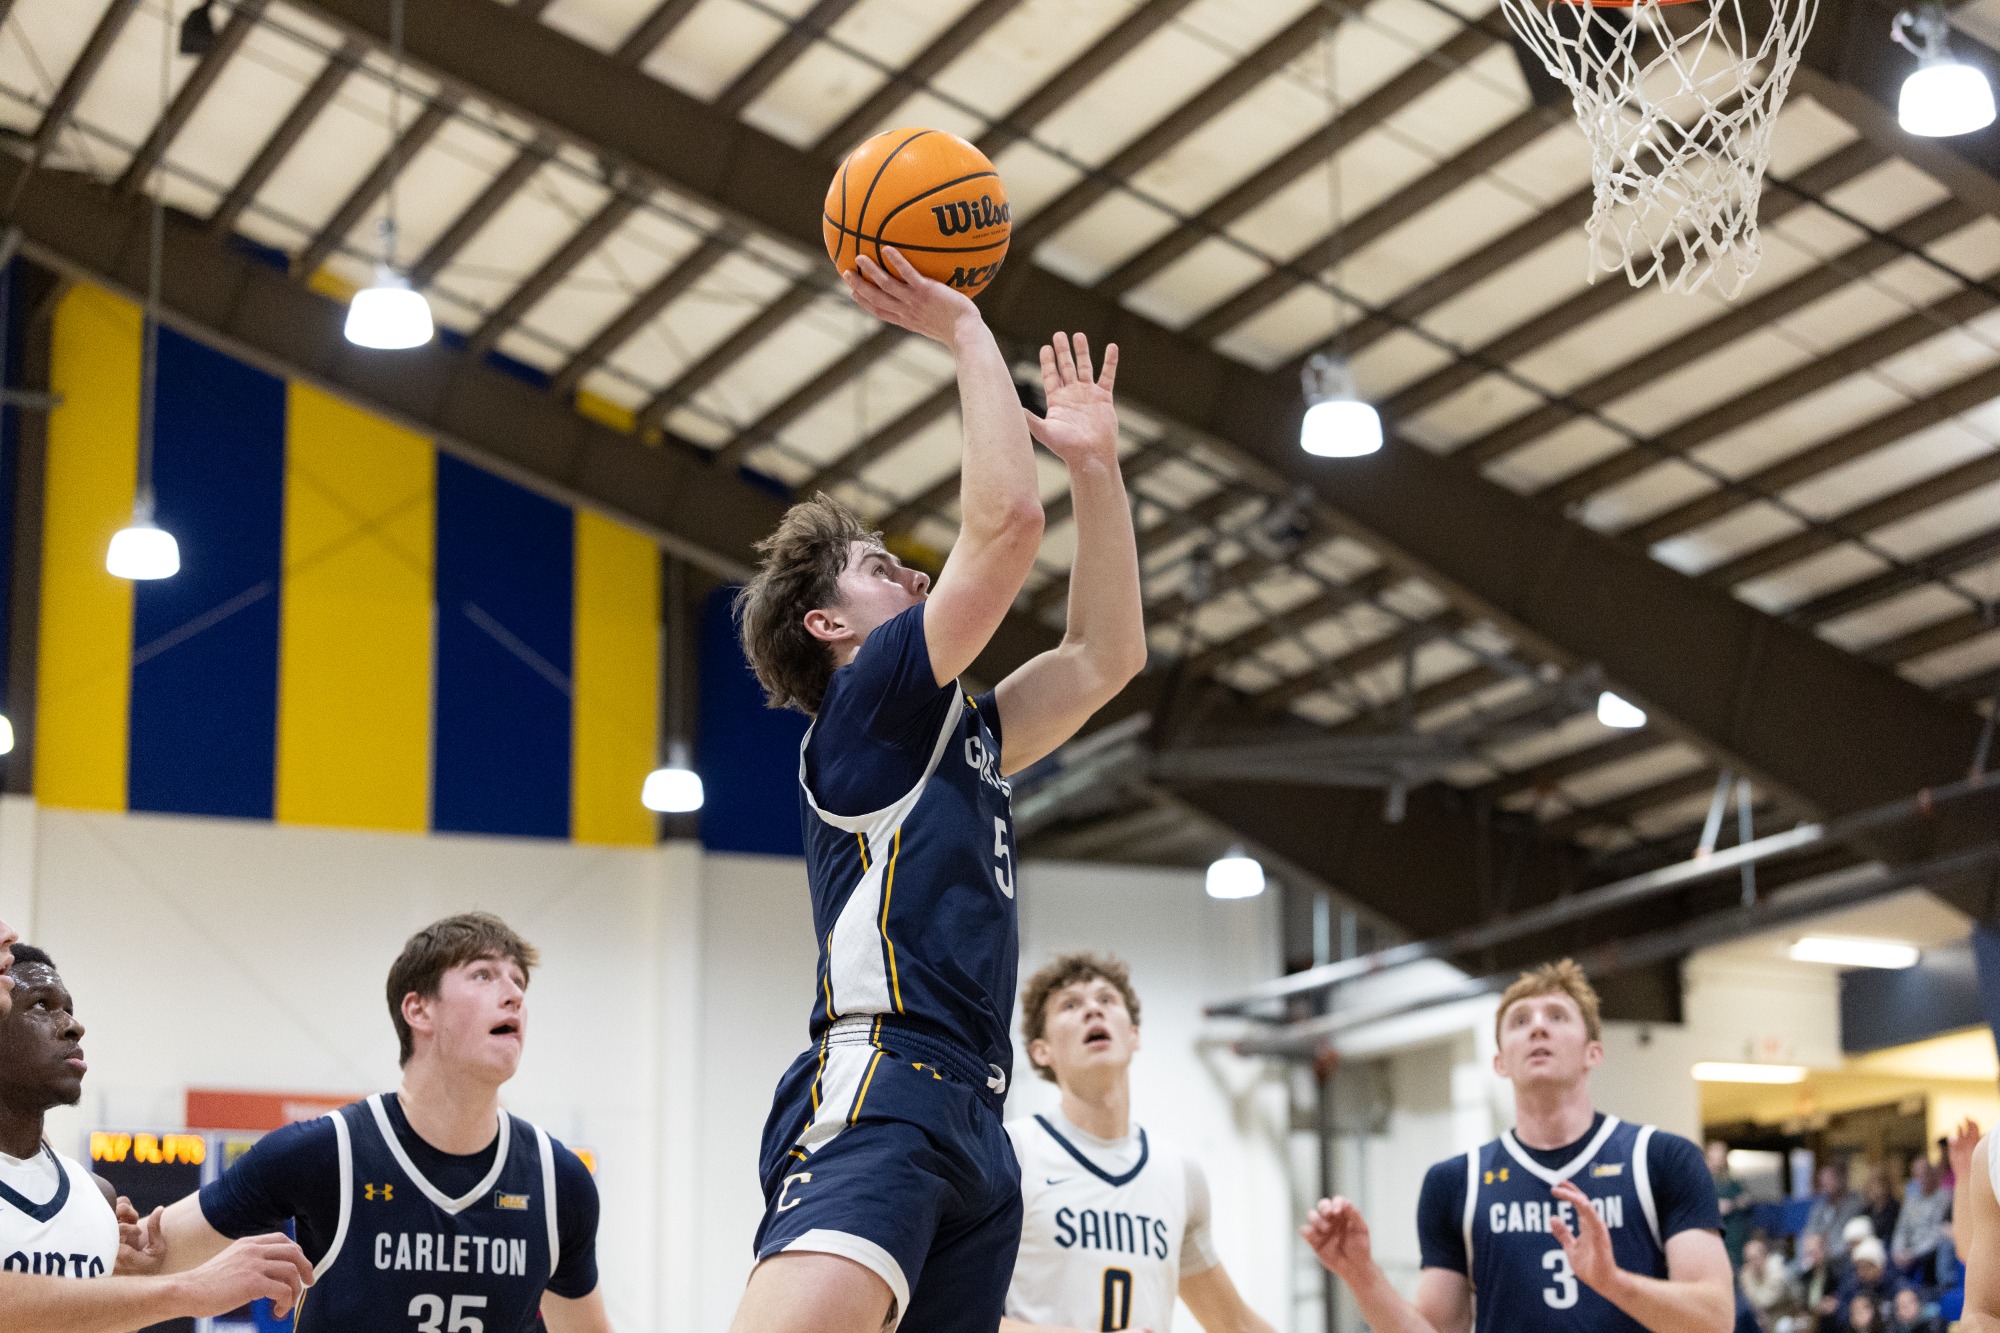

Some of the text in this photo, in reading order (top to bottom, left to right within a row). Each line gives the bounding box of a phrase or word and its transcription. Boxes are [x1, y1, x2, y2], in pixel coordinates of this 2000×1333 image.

[994, 816, 1014, 899] 5
[374, 1232, 527, 1276] CARLETON
[1054, 1206, 1169, 1261] SAINTS
[1101, 1266, 1133, 1332] 0
[1541, 1249, 1579, 1310] 3
[407, 1293, 488, 1333] 35
